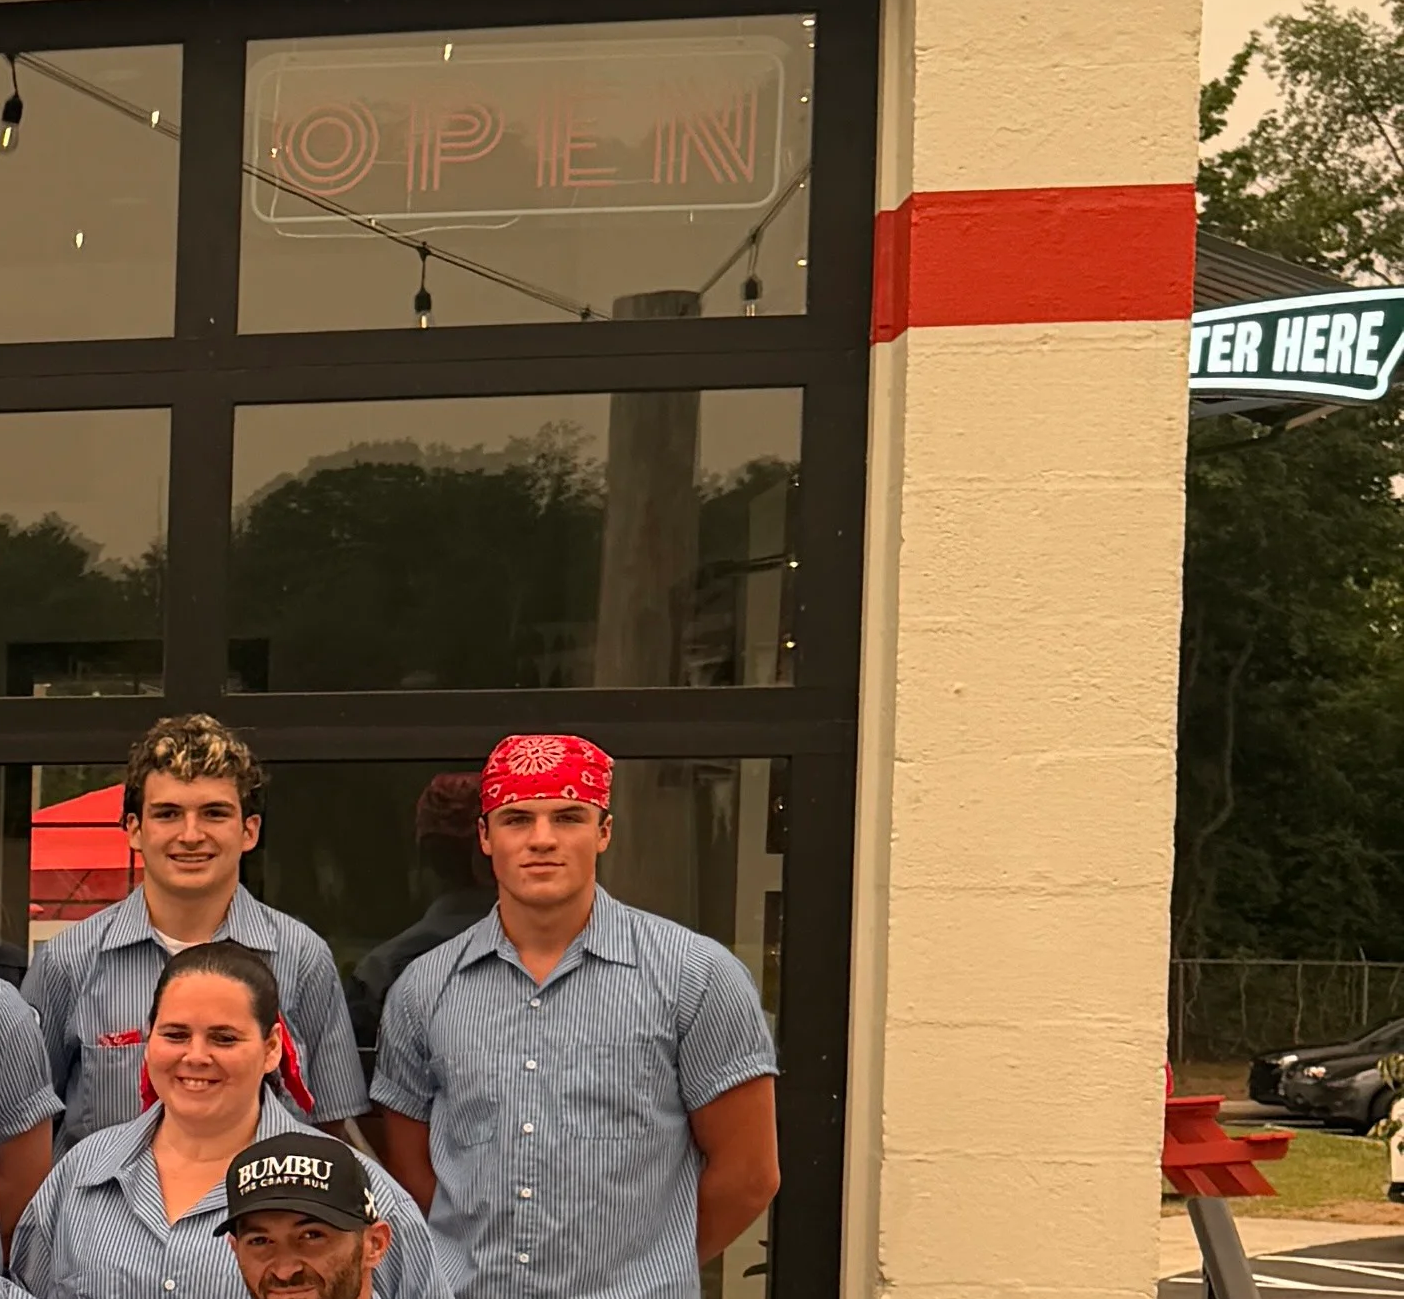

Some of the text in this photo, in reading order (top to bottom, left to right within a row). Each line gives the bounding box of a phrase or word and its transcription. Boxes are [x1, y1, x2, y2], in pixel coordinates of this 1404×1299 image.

[276, 87, 759, 197] OPEN
[1271, 310, 1385, 376] HERE
[237, 1154, 334, 1189] BUMBU
